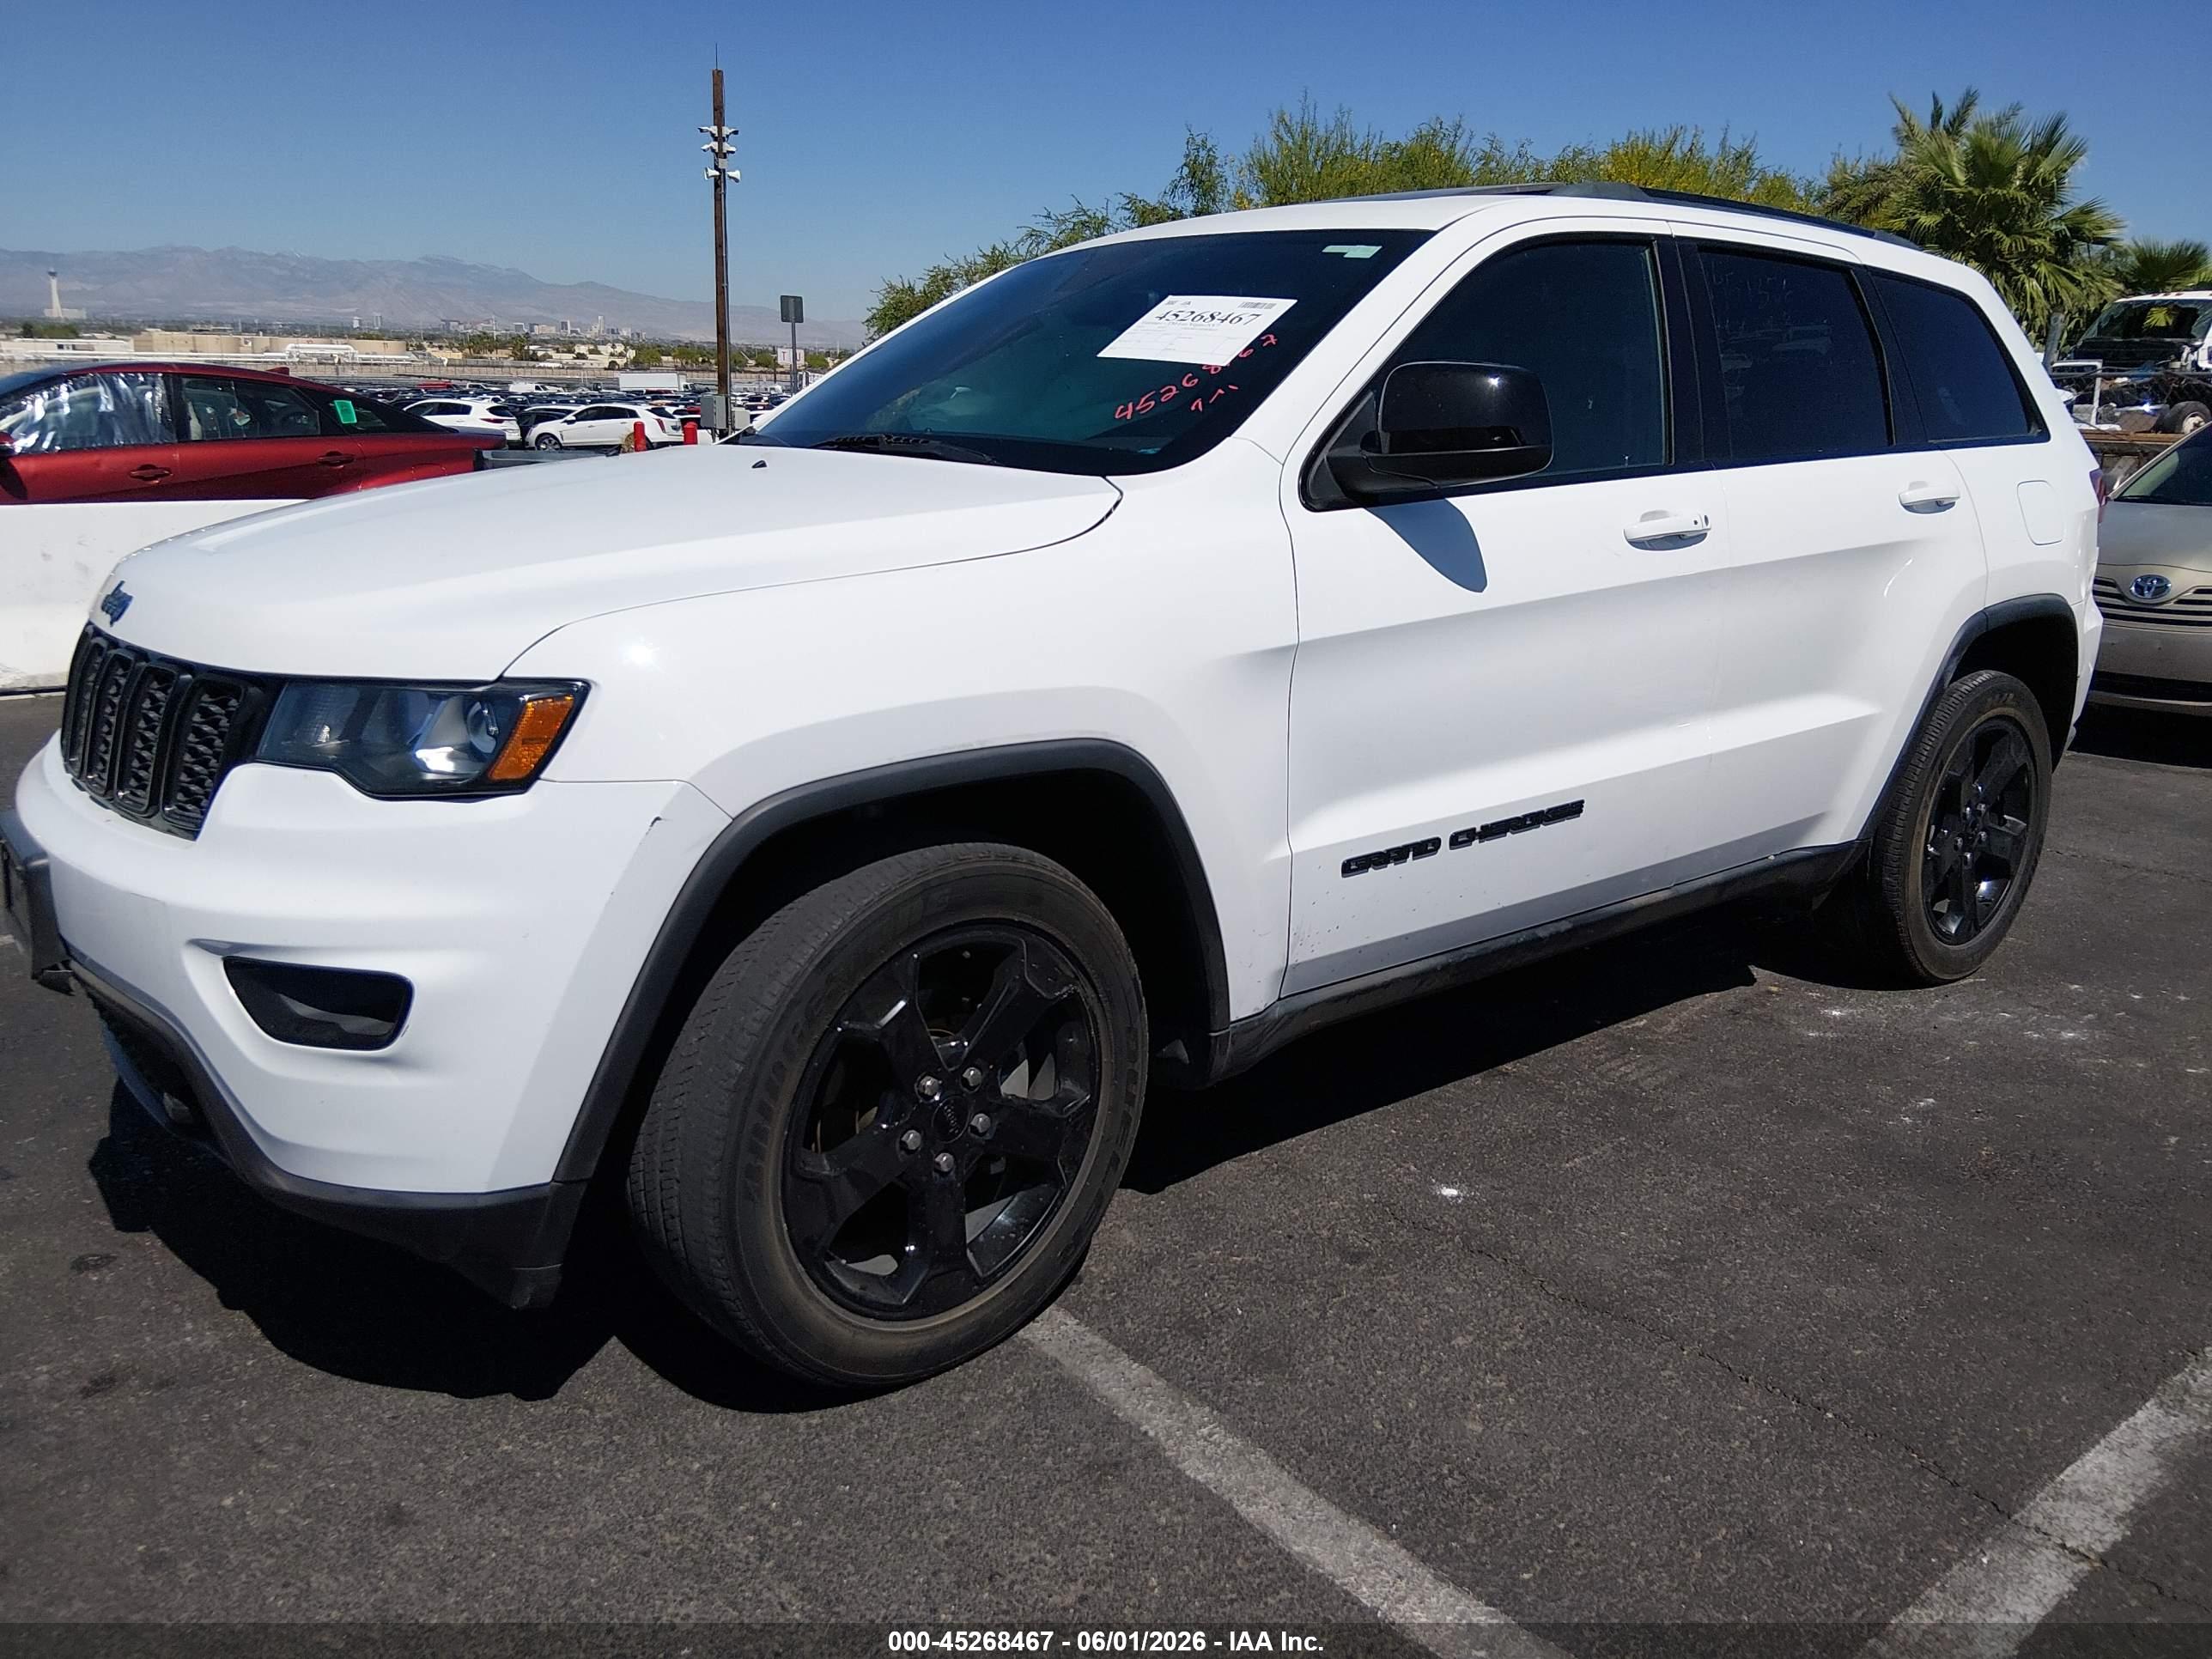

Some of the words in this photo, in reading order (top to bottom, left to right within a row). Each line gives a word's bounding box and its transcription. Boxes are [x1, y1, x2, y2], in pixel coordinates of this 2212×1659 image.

[1155, 309, 1263, 325] 45268467
[1115, 333, 1278, 420] 4526867
[1340, 836, 1442, 878] GRAND
[1449, 799, 1585, 851] CHEROKEE
